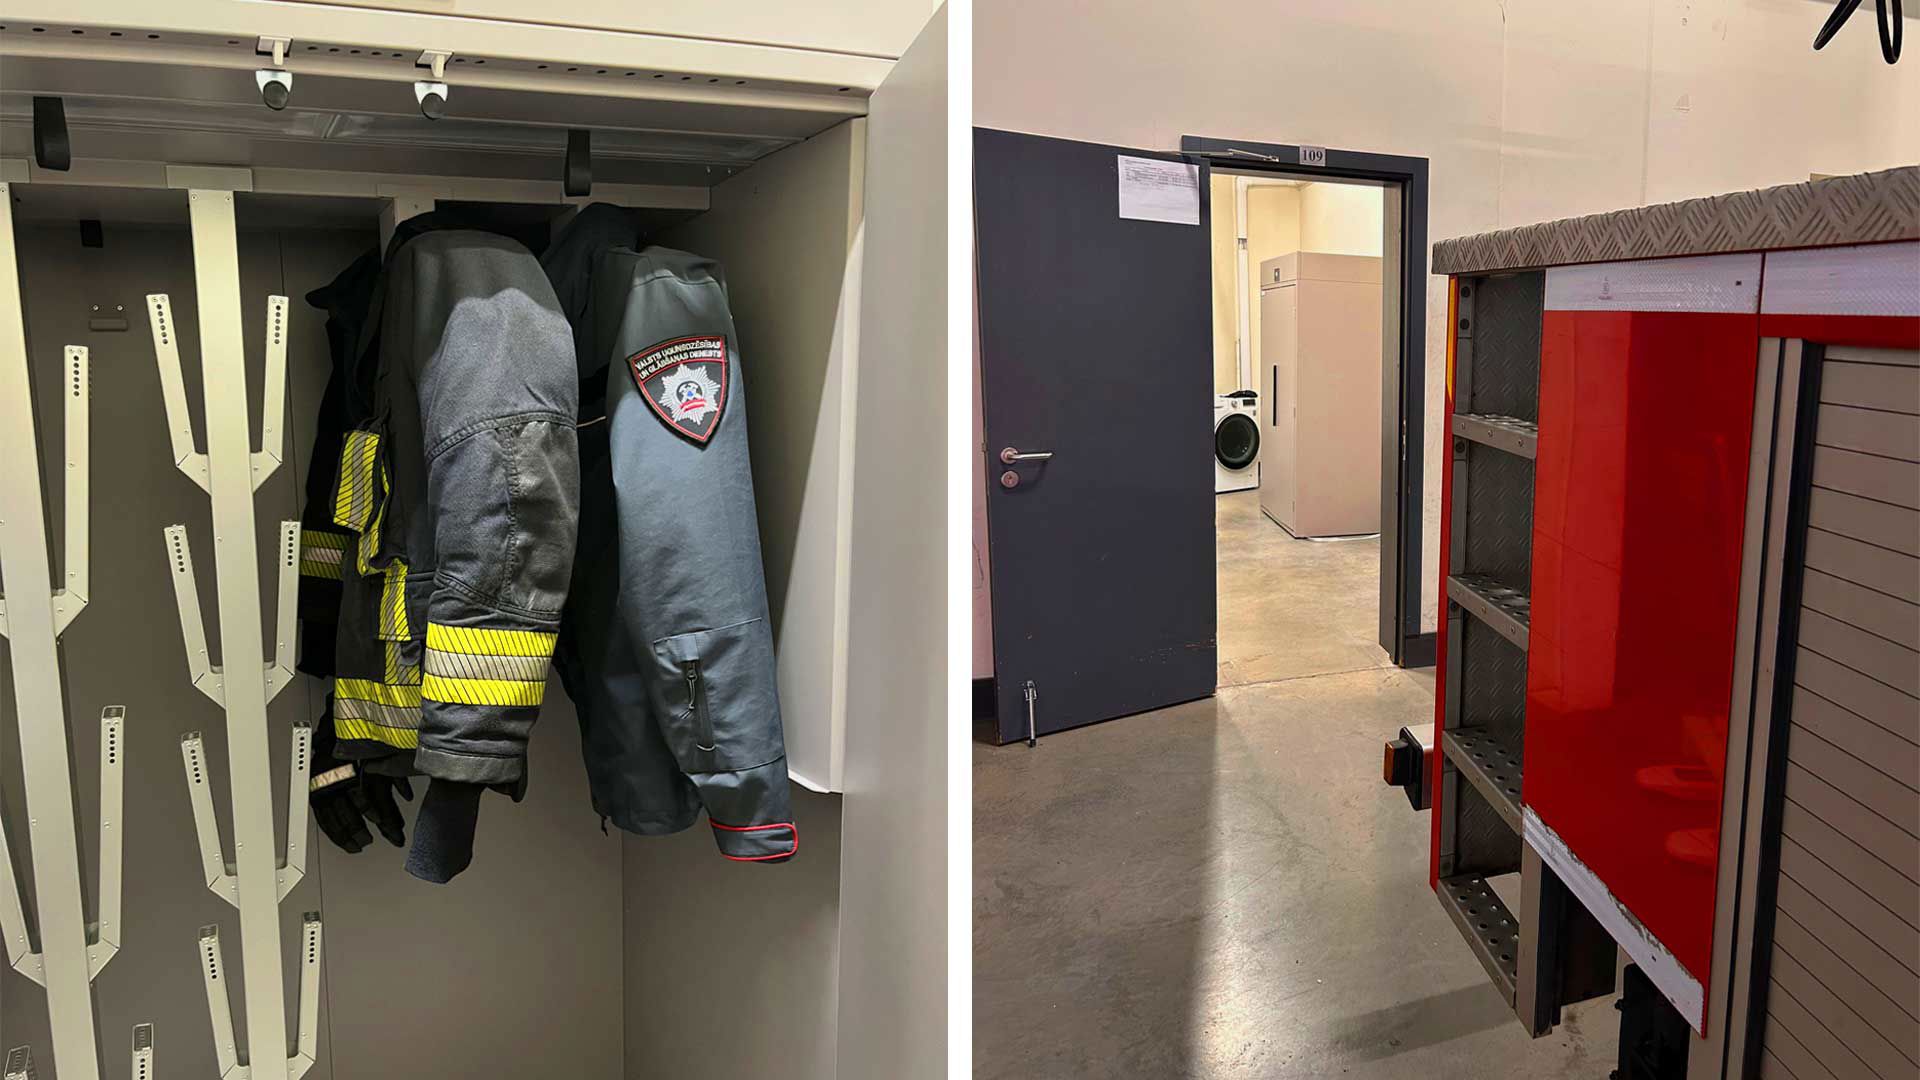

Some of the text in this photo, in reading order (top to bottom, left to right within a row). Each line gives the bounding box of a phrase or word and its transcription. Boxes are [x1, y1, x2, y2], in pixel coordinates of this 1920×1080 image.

[1303, 150, 1323, 161] 109
[635, 351, 661, 370] VALSTS
[639, 370, 650, 380] UN
[689, 349, 722, 358] DIENESTS
